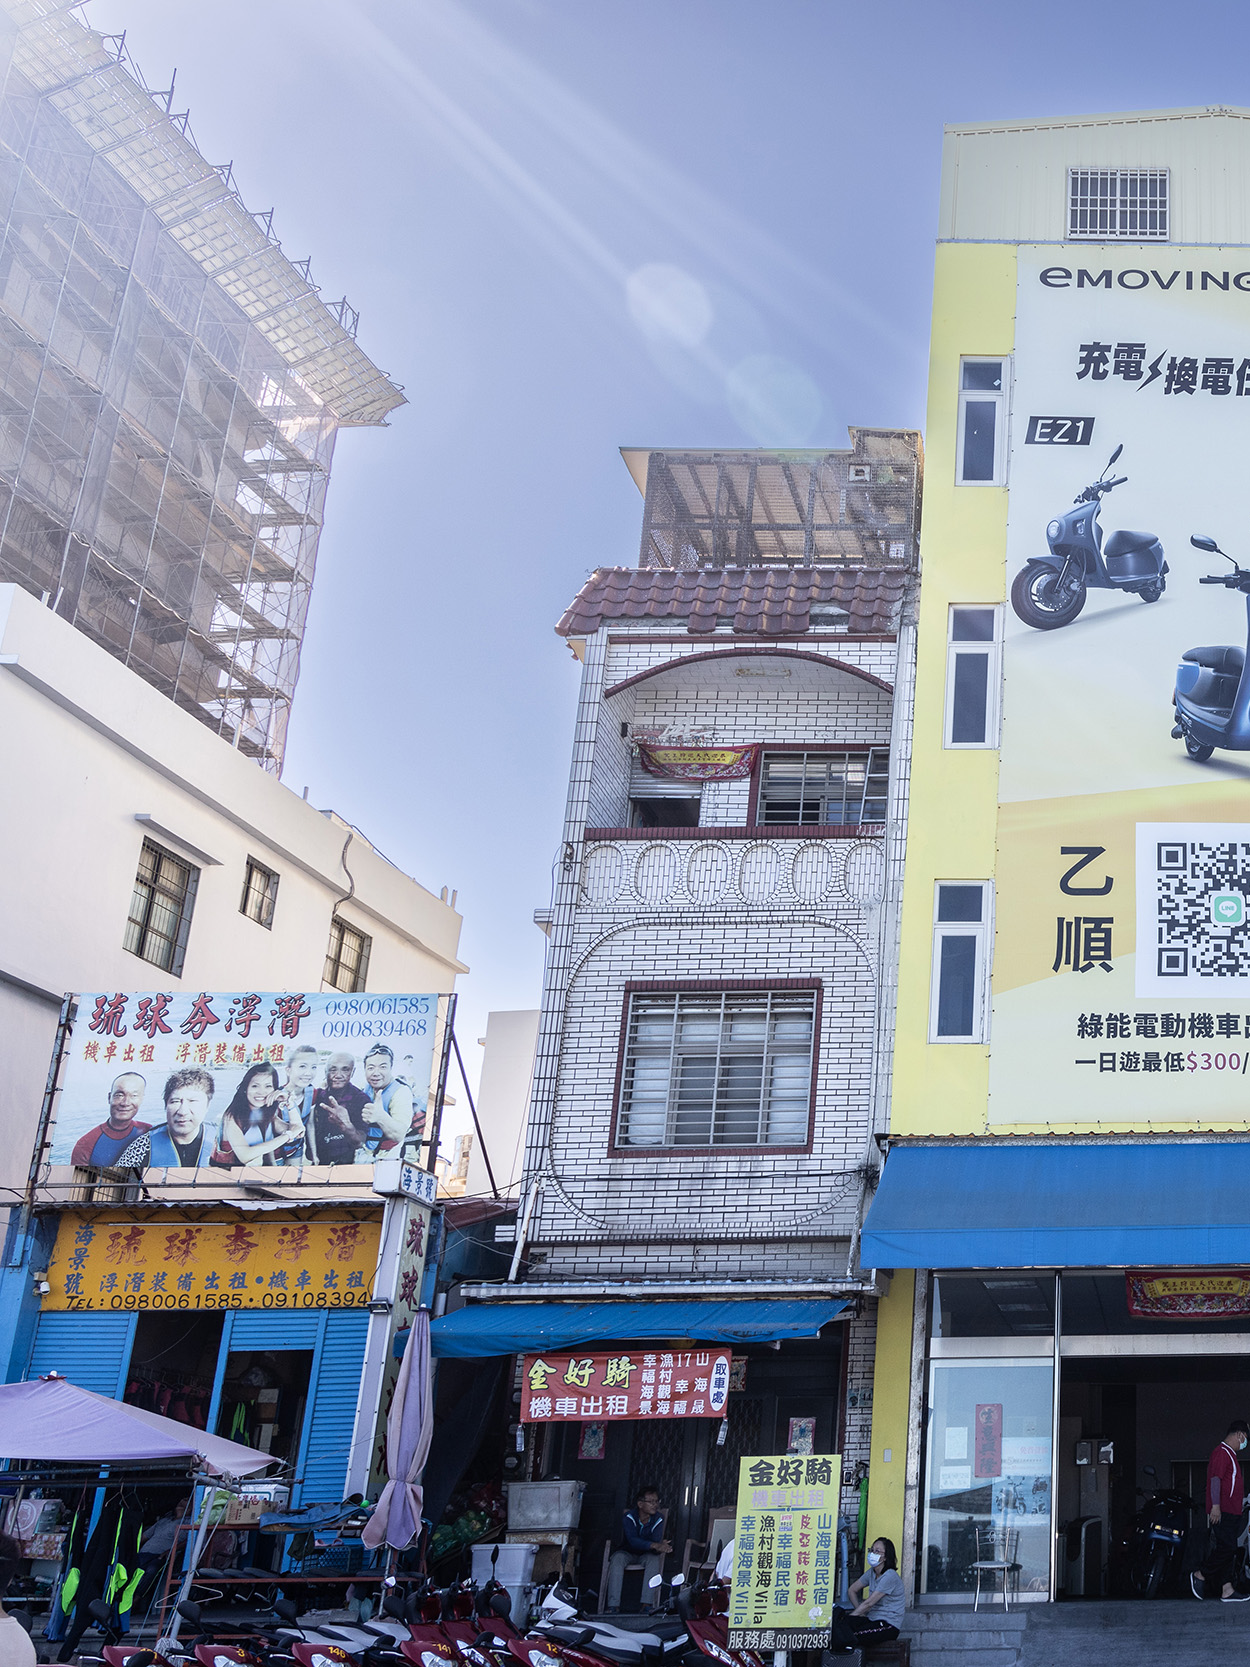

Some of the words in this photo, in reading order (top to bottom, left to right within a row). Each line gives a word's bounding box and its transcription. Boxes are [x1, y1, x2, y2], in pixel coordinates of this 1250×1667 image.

[1034, 419, 1086, 443] EZ1
[325, 997, 430, 1017] 0980061585
[322, 1015, 428, 1038] 0910839468
[83, 1041, 155, 1064] 機車出租
[175, 1041, 286, 1064] 浮潛裝備出租
[64, 1223, 97, 1295] 海景號
[711, 1362, 727, 1404] 取車處
[529, 1395, 629, 1418] 機車出租
[748, 1457, 833, 1487] 金好騎
[751, 1489, 825, 1508] 機車出租
[773, 1533, 793, 1607] 幸福民宿
[813, 1513, 832, 1605] 山海晟民宿
[727, 1630, 776, 1649] 服務處
